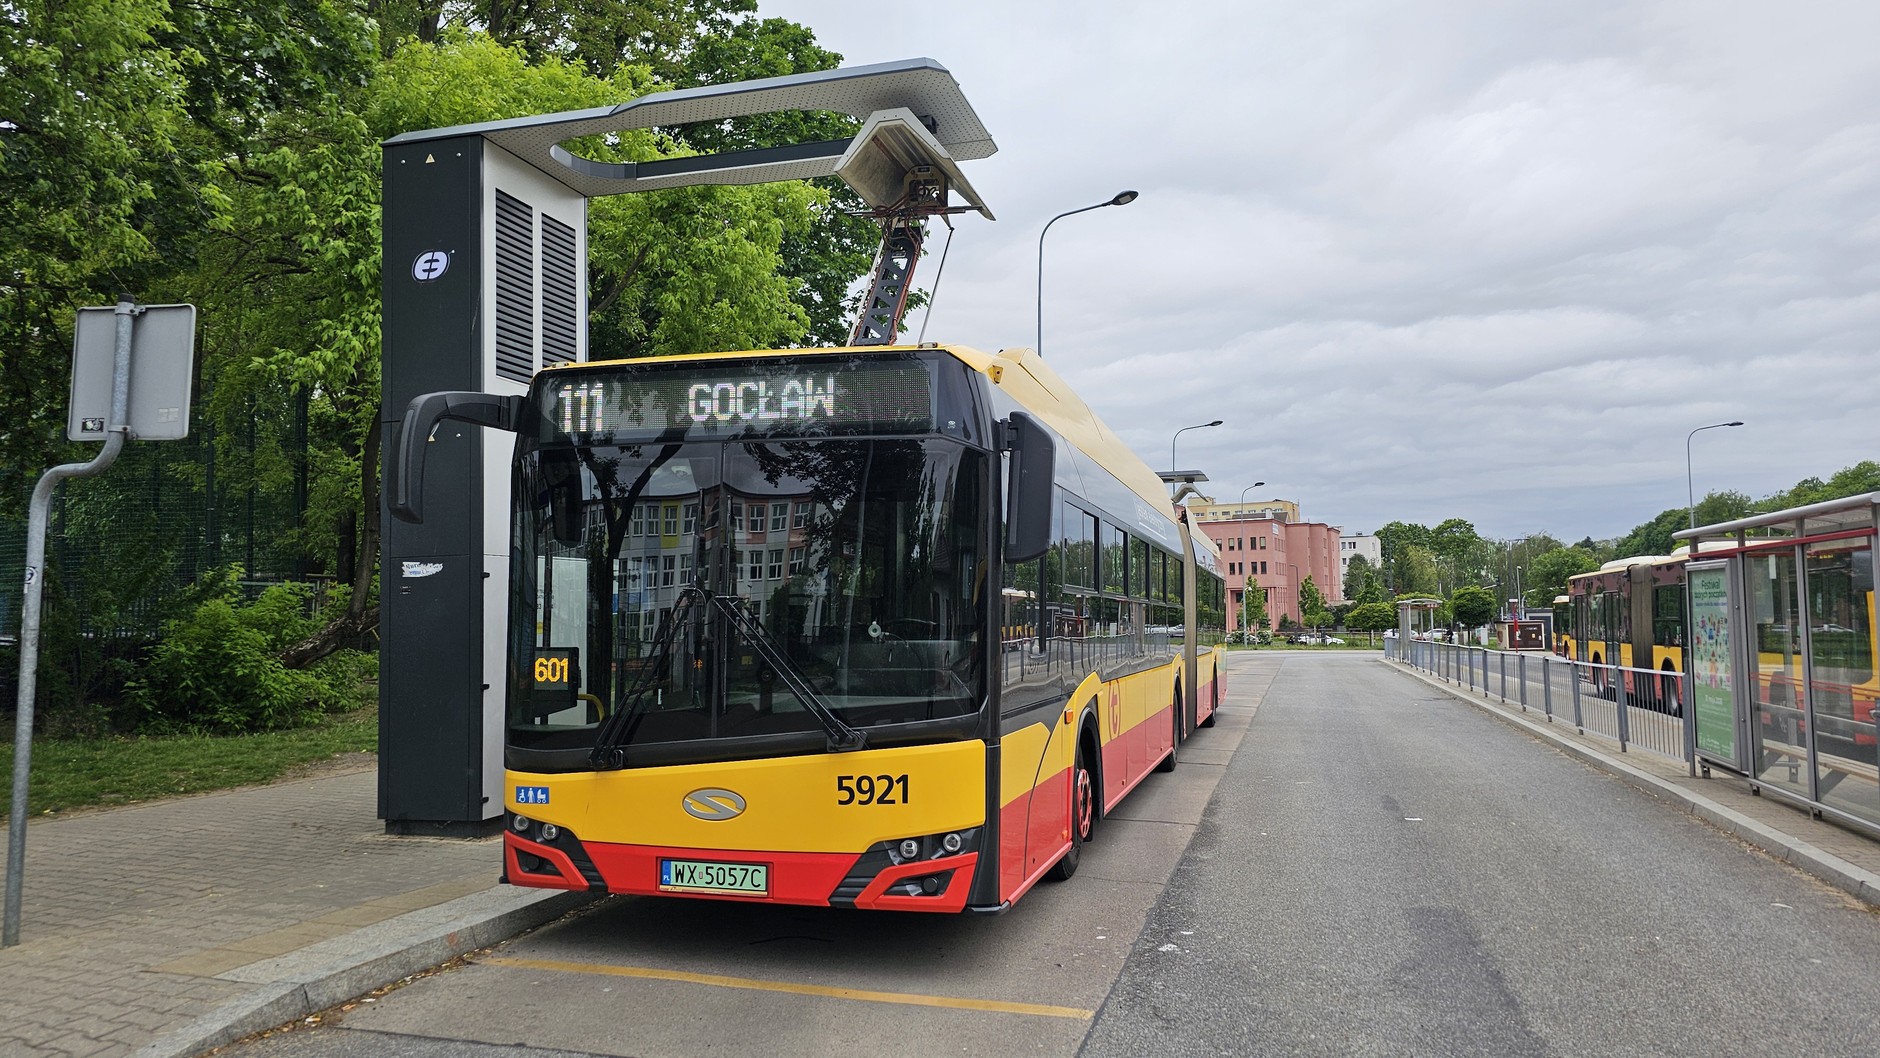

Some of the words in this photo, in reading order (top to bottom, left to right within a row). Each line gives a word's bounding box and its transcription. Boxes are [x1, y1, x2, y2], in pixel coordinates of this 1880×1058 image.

[558, 383, 604, 433] 111
[687, 376, 835, 422] GOCŁAW
[534, 657, 569, 683] 601
[836, 774, 910, 806] 5921
[674, 864, 698, 884] WX
[704, 866, 762, 888] 5057C
